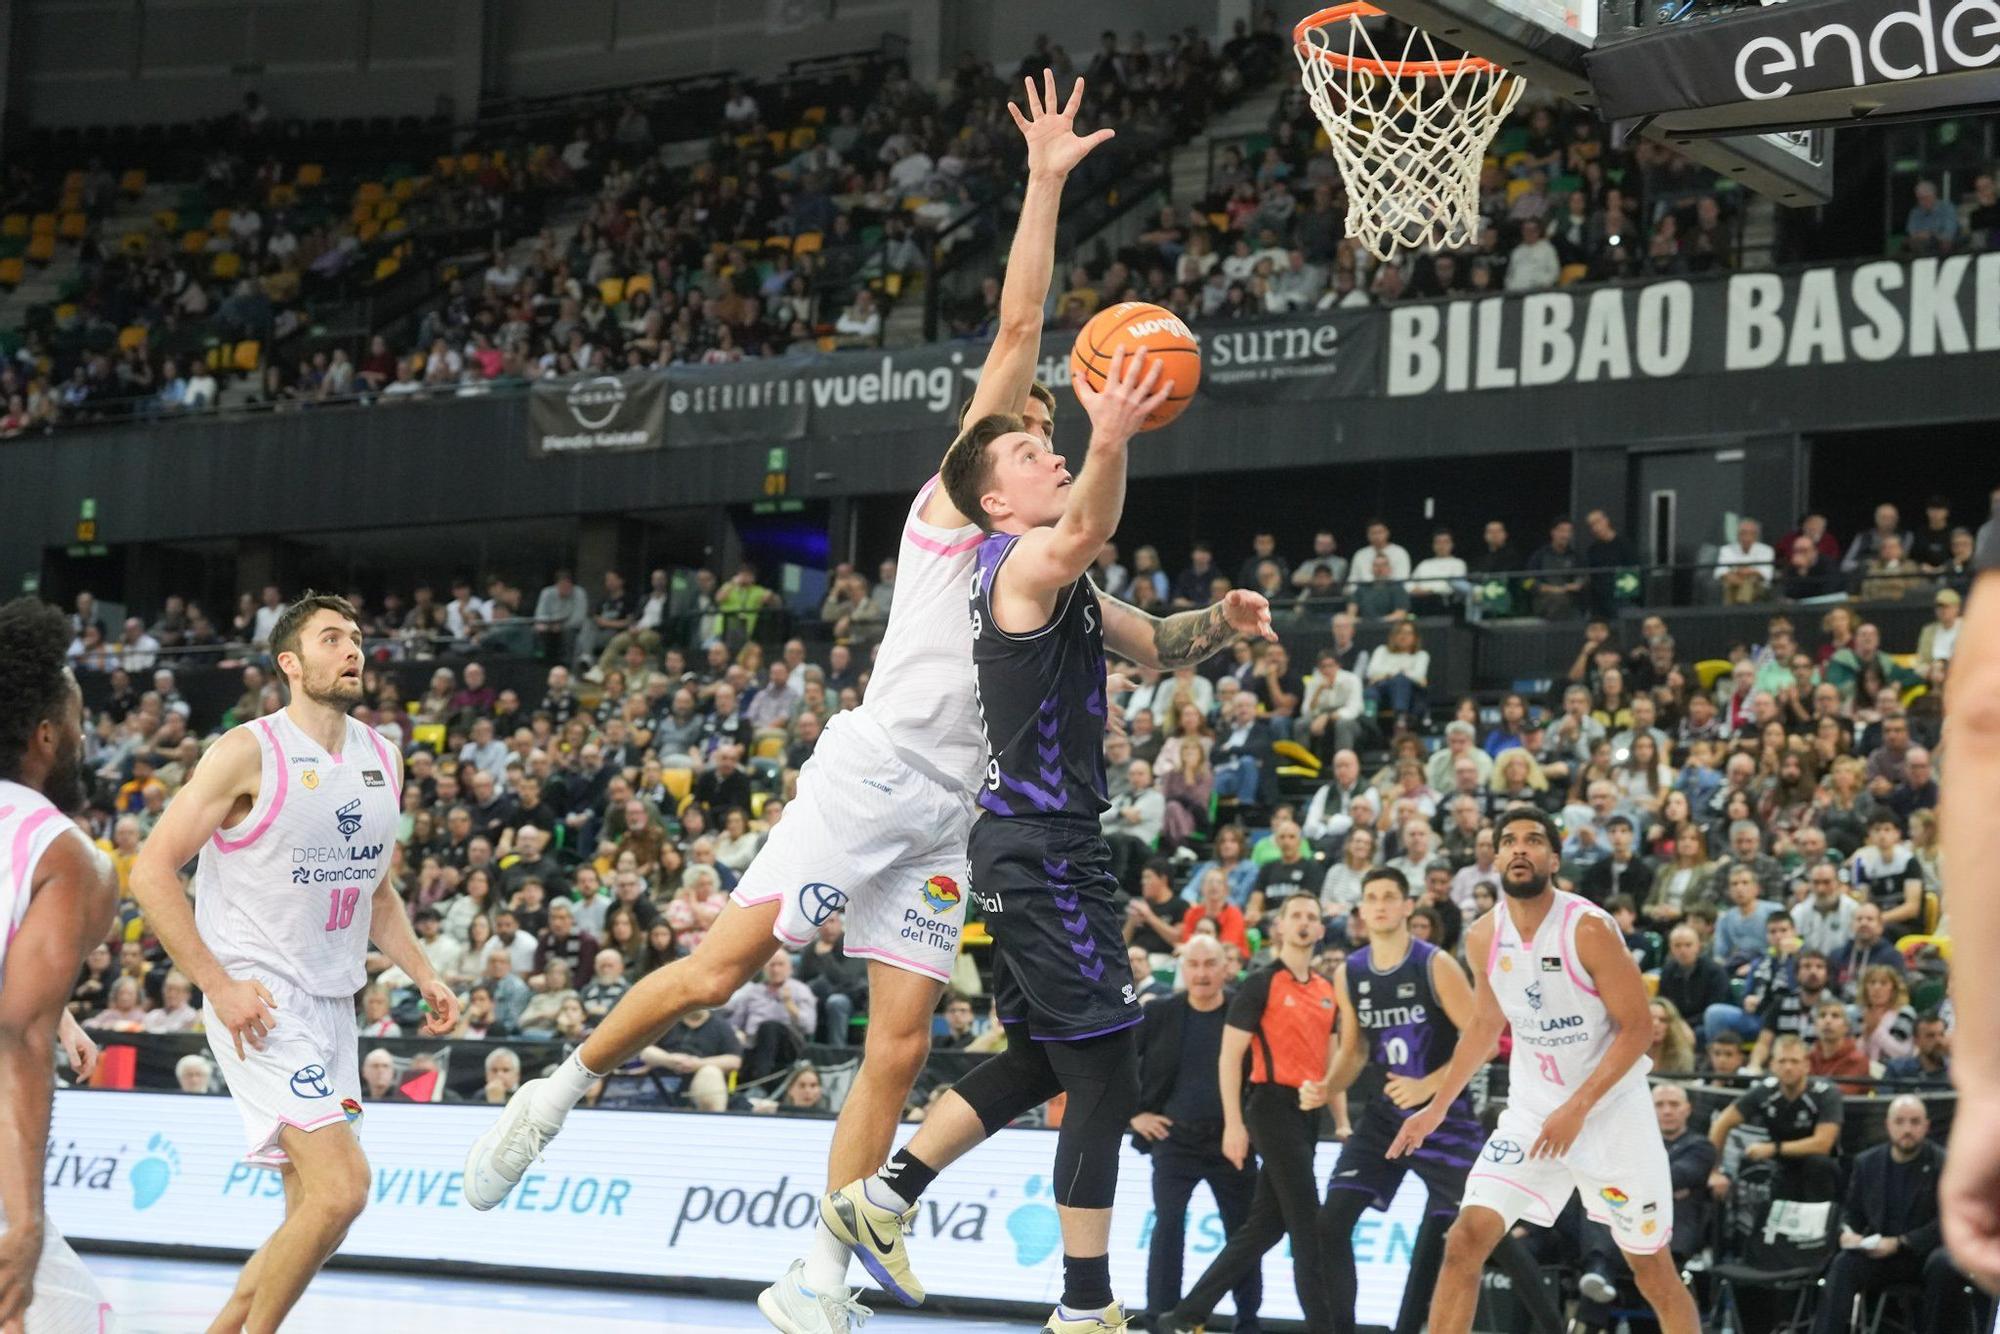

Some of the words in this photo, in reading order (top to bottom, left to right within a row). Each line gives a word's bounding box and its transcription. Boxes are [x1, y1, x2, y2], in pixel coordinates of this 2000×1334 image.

[1210, 325, 1338, 366] surne
[1387, 279, 1693, 396] BILBAO
[812, 355, 963, 412] vueling
[325, 886, 361, 932] 18
[903, 908, 959, 938] Poema
[900, 926, 924, 943] del
[373, 1168, 464, 1207] VIVE
[499, 1173, 632, 1217] EJOR
